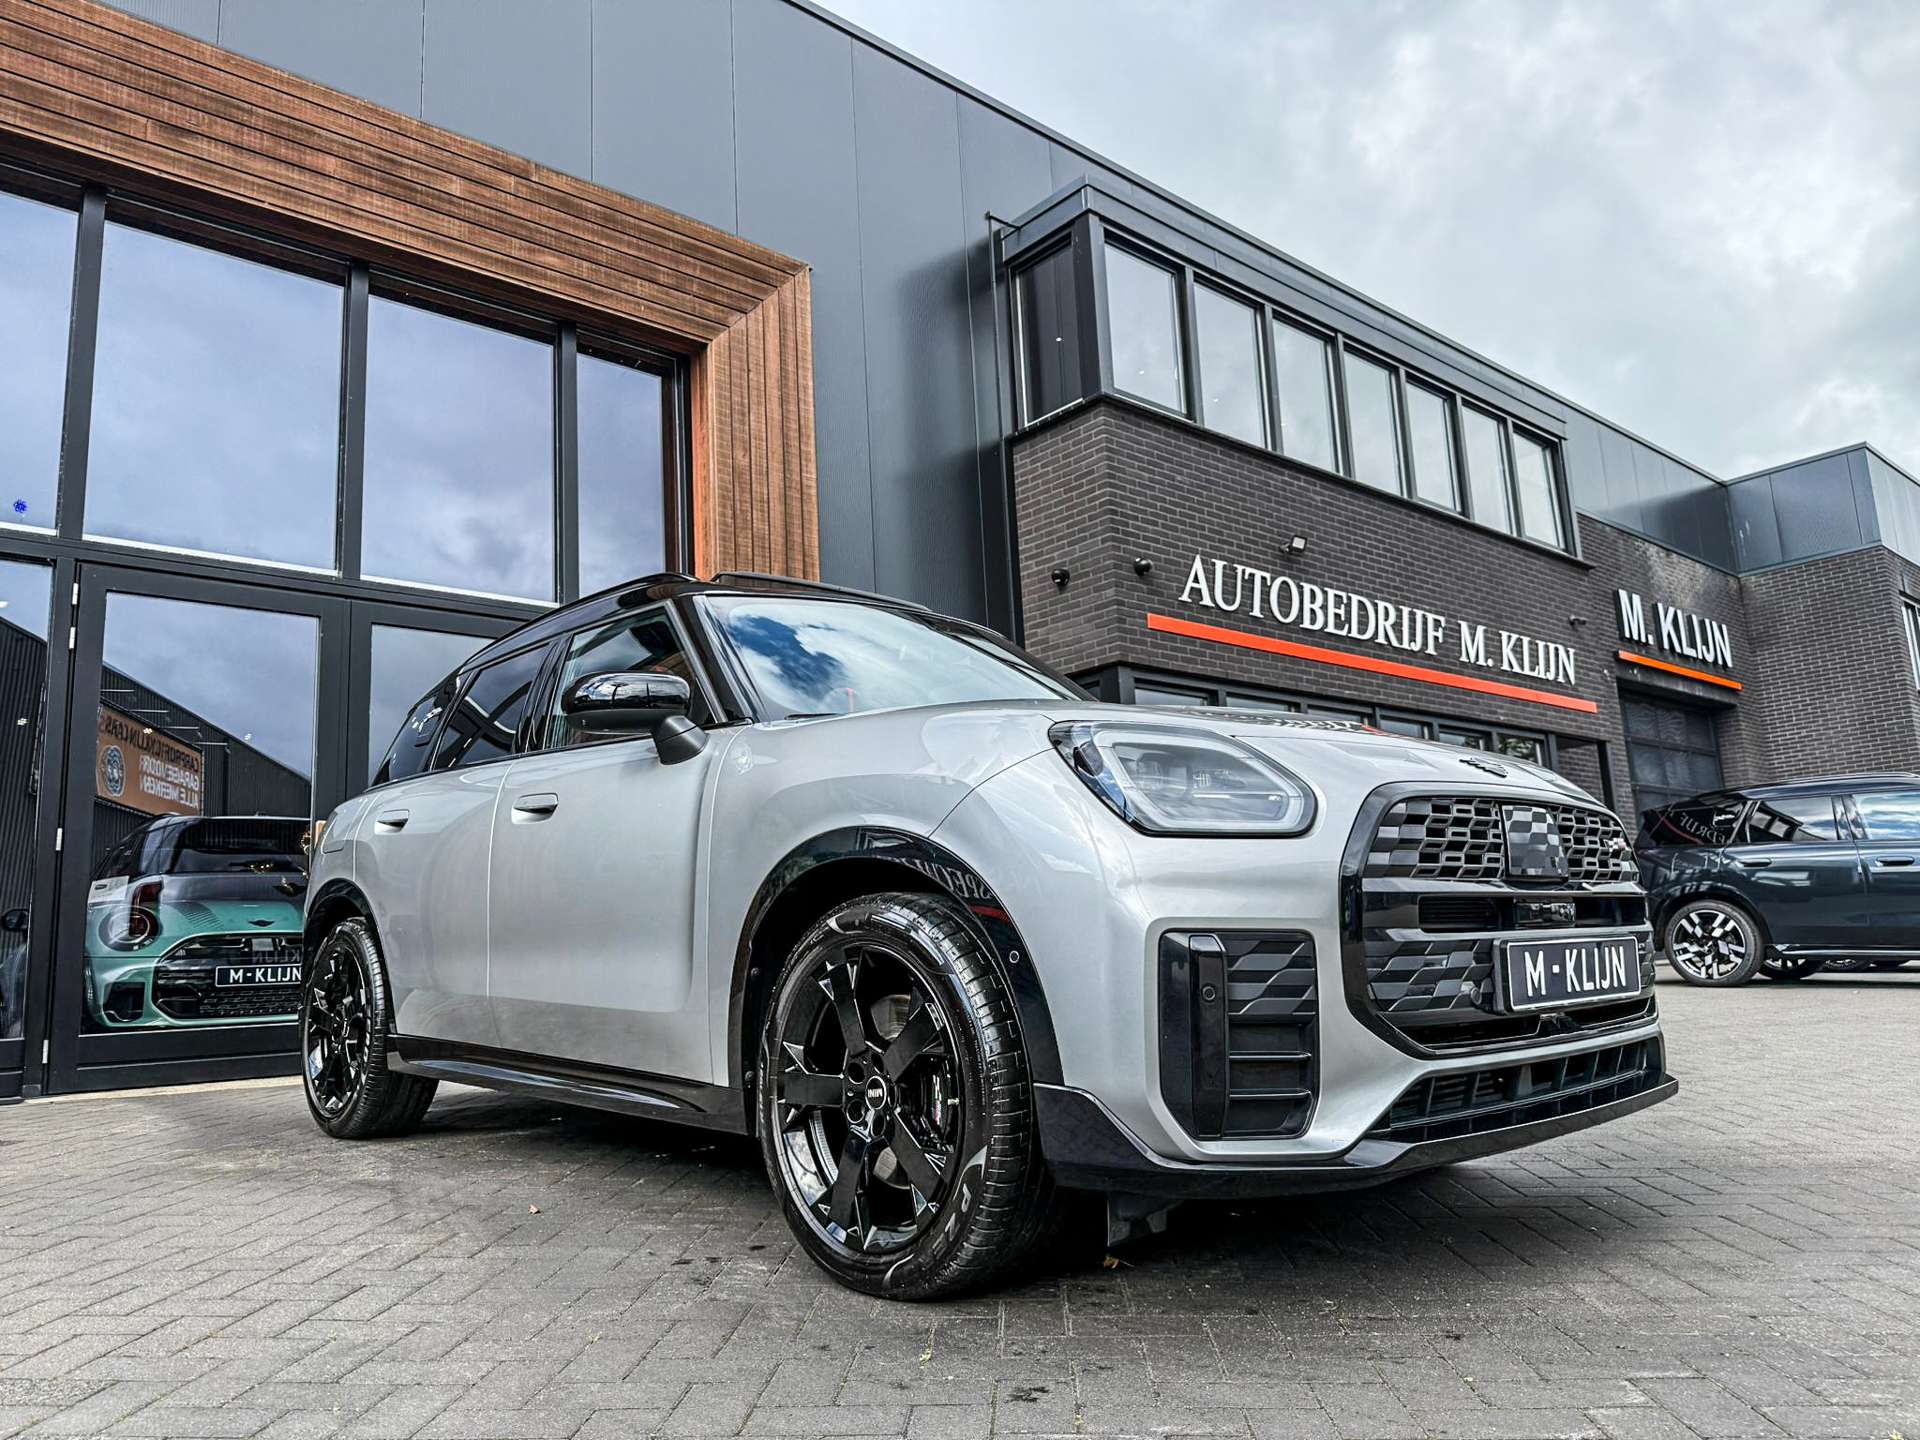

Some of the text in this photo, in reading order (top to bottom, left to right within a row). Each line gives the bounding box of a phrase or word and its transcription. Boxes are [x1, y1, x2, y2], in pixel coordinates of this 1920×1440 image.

[1178, 554, 1576, 686] AUTOBEDRIJF M. KLIJN
[1618, 588, 1733, 668] M. KLIJN
